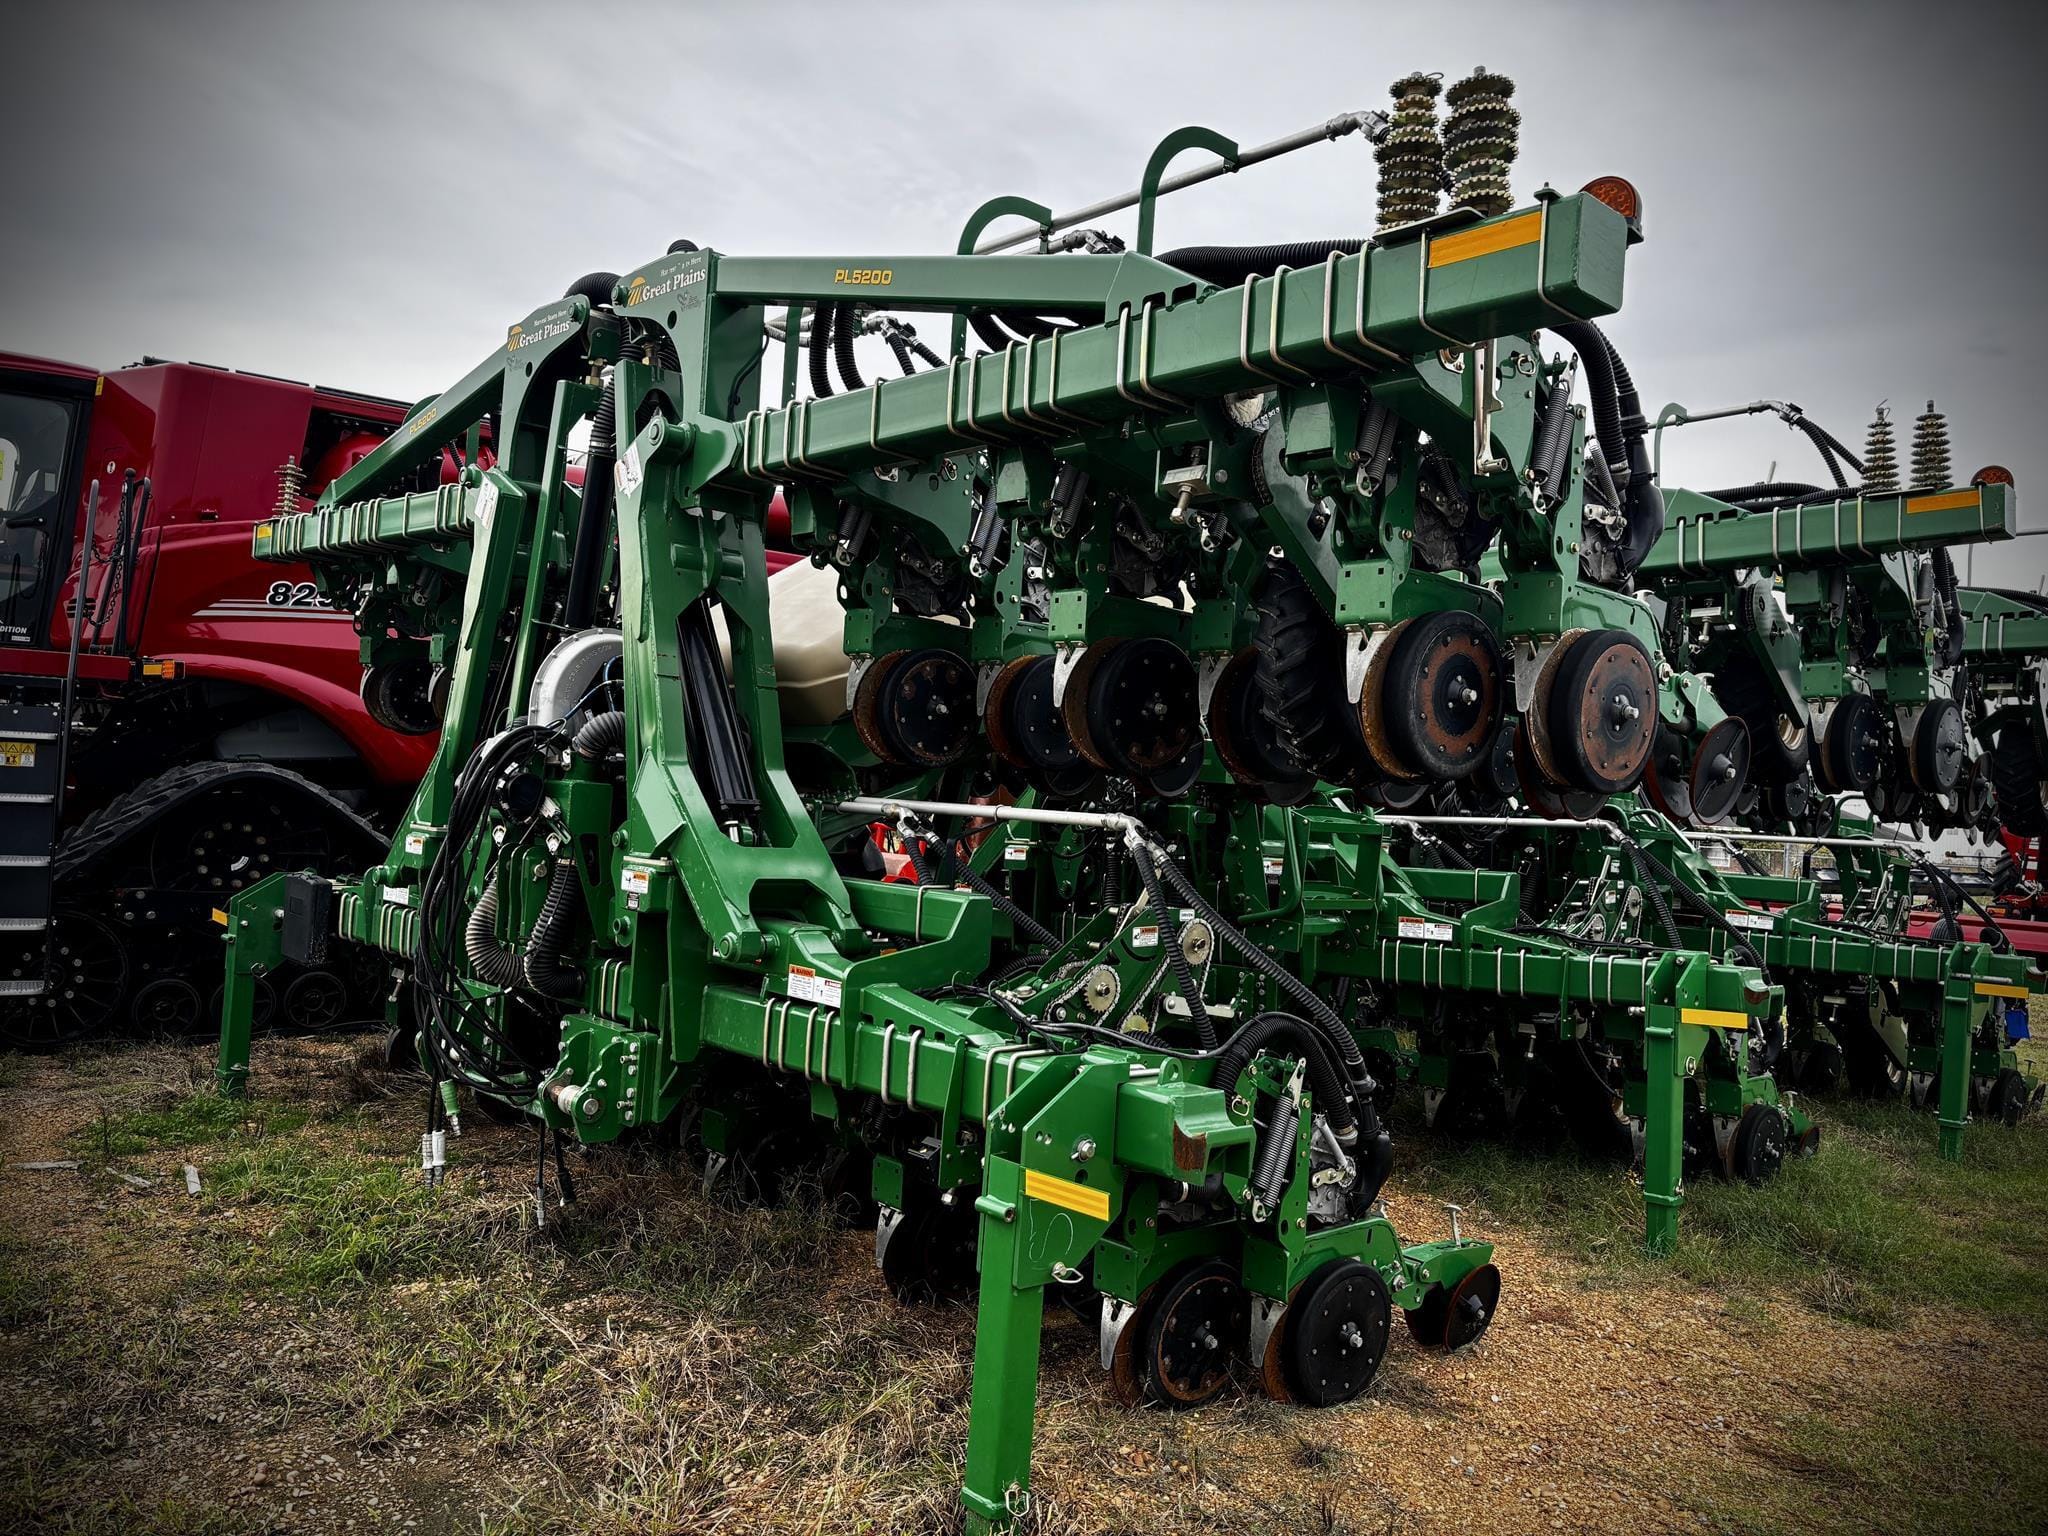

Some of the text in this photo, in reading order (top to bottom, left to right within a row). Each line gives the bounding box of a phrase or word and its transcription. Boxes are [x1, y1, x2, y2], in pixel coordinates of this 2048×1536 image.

[641, 279, 672, 302] Great
[672, 268, 706, 291] Plains
[834, 269, 893, 285] PL5200
[519, 320, 570, 348] Great Plains
